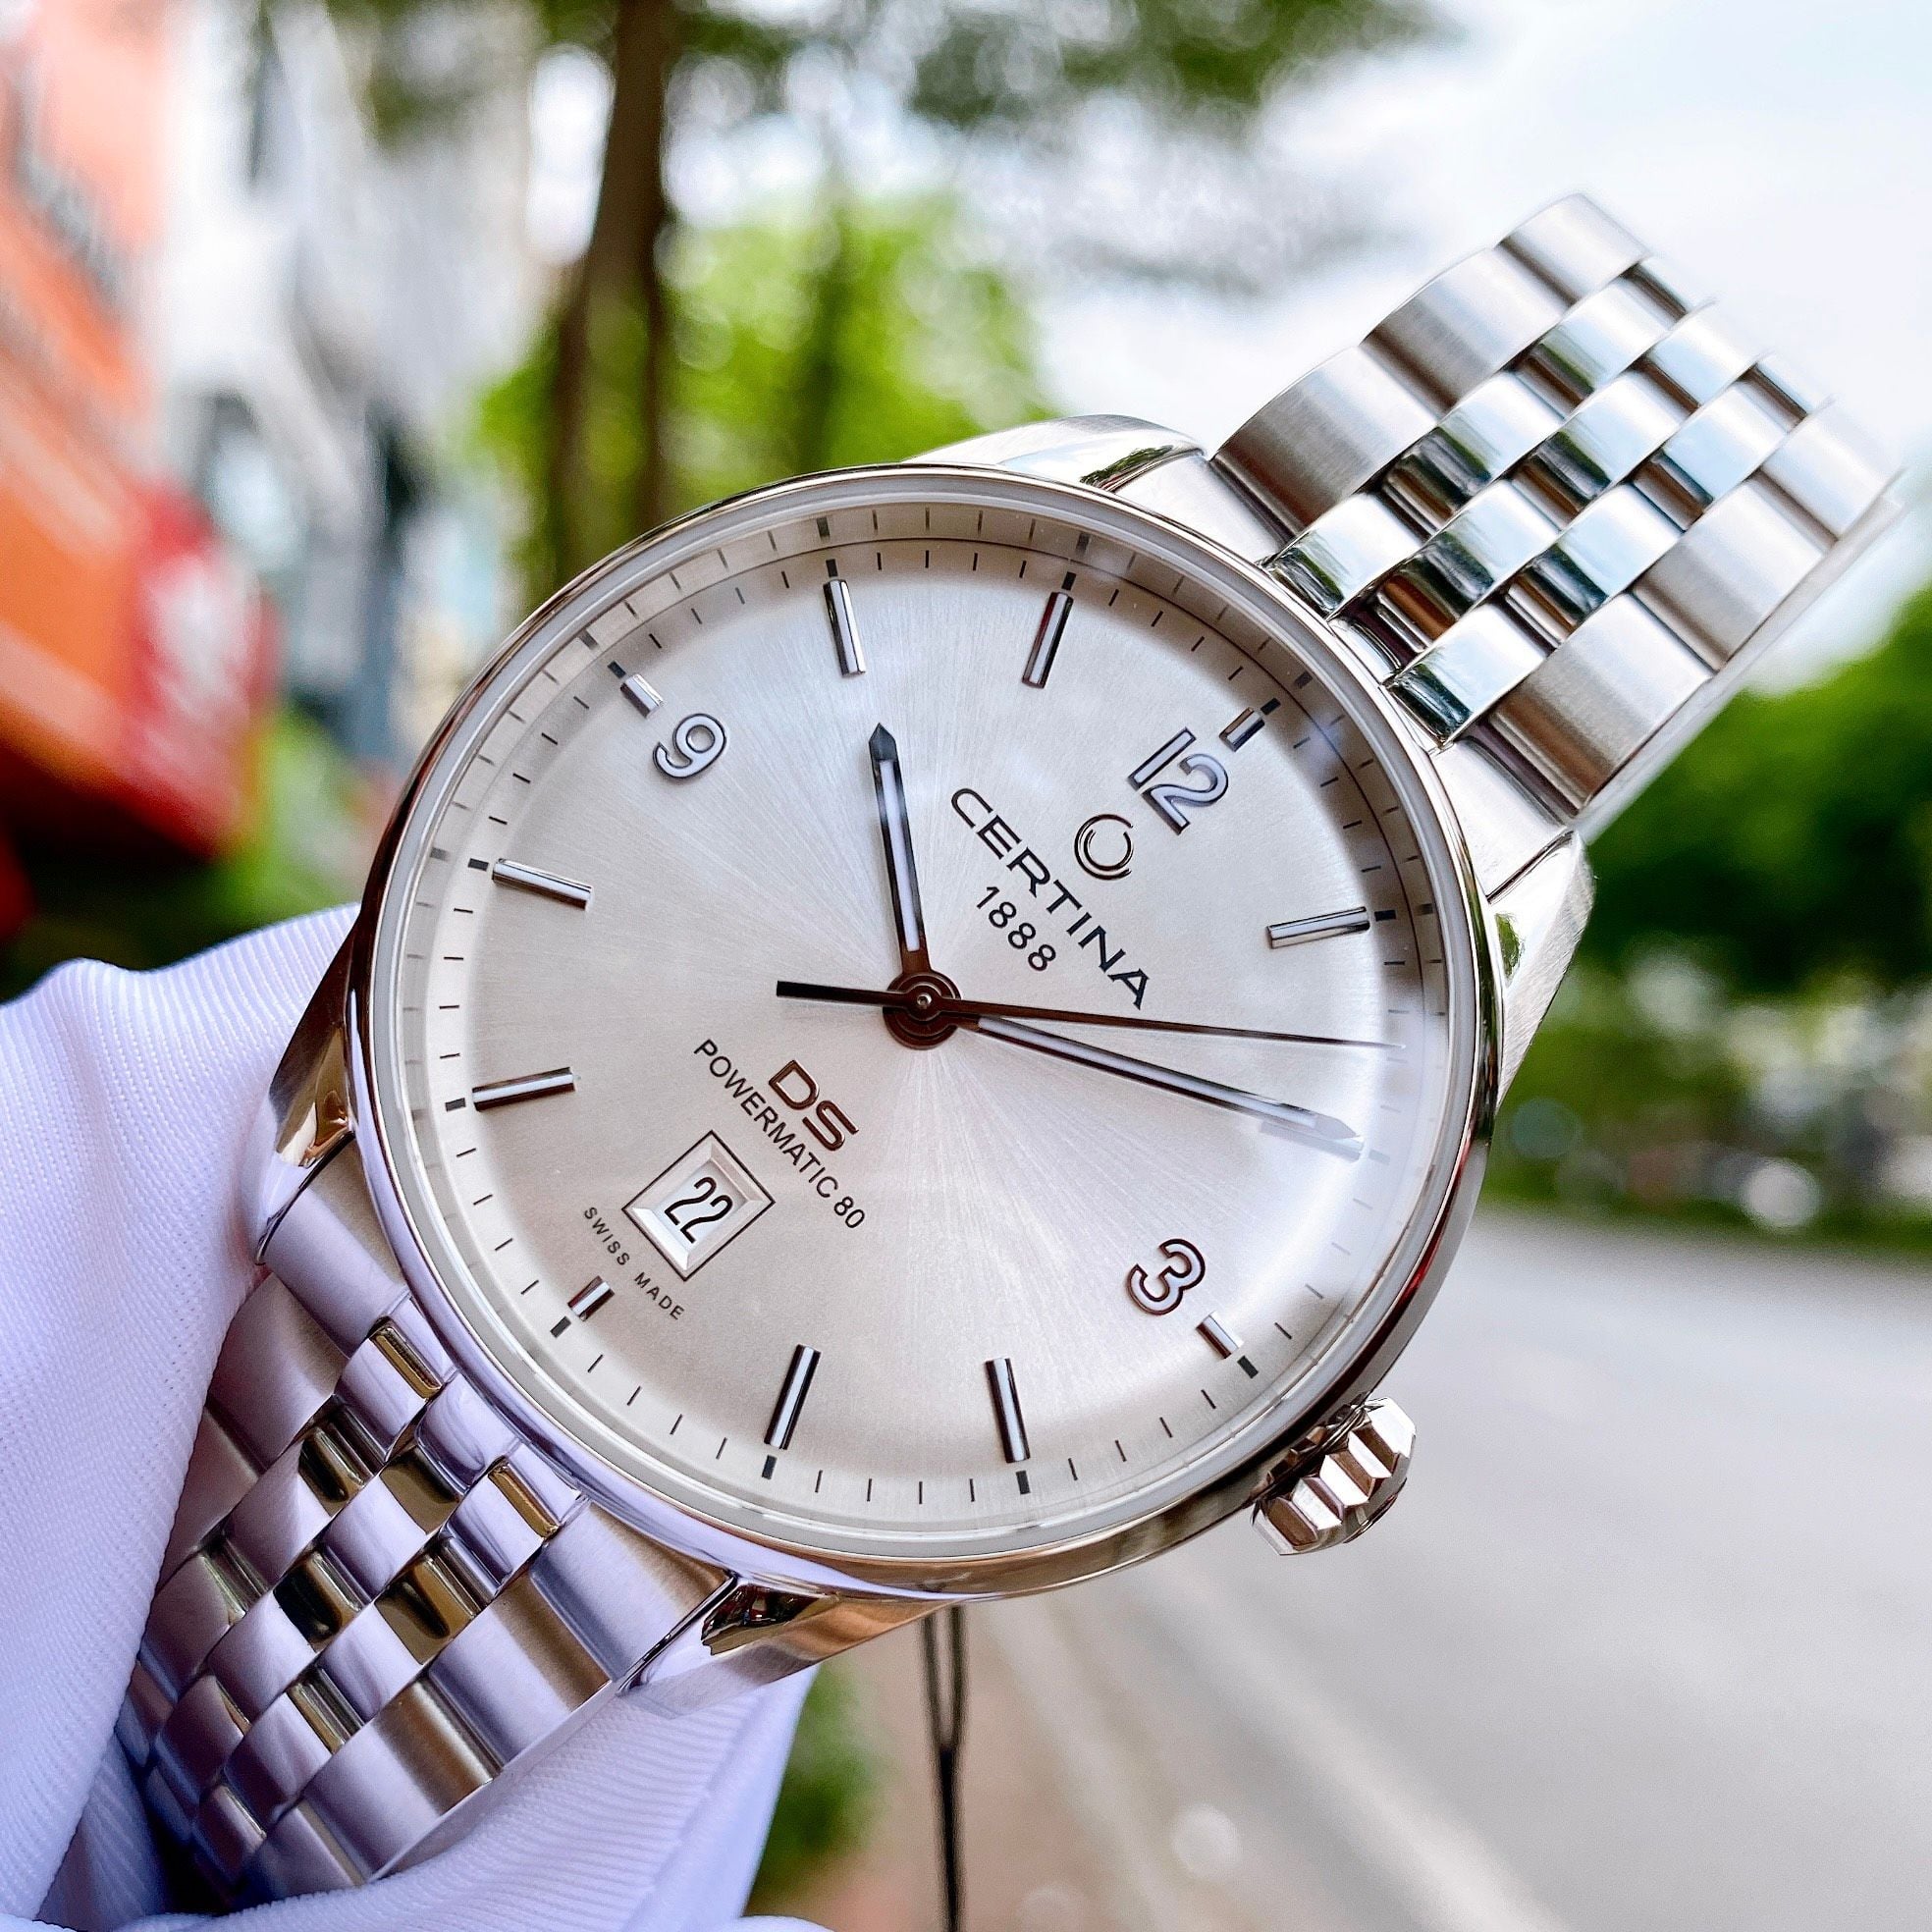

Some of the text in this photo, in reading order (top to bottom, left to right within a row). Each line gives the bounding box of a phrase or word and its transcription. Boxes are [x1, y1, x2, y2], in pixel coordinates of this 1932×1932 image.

[653, 713, 726, 778] 9
[1127, 726, 1229, 835] 12
[950, 787, 1150, 1010] CERTINA
[976, 886, 1056, 972] 1888
[693, 1039, 866, 1229] POWERMATIC 80
[768, 1059, 859, 1152] DS
[665, 1176, 733, 1244] 22
[584, 1207, 684, 1320] SWISS MADE
[1127, 1238, 1206, 1315] 3
